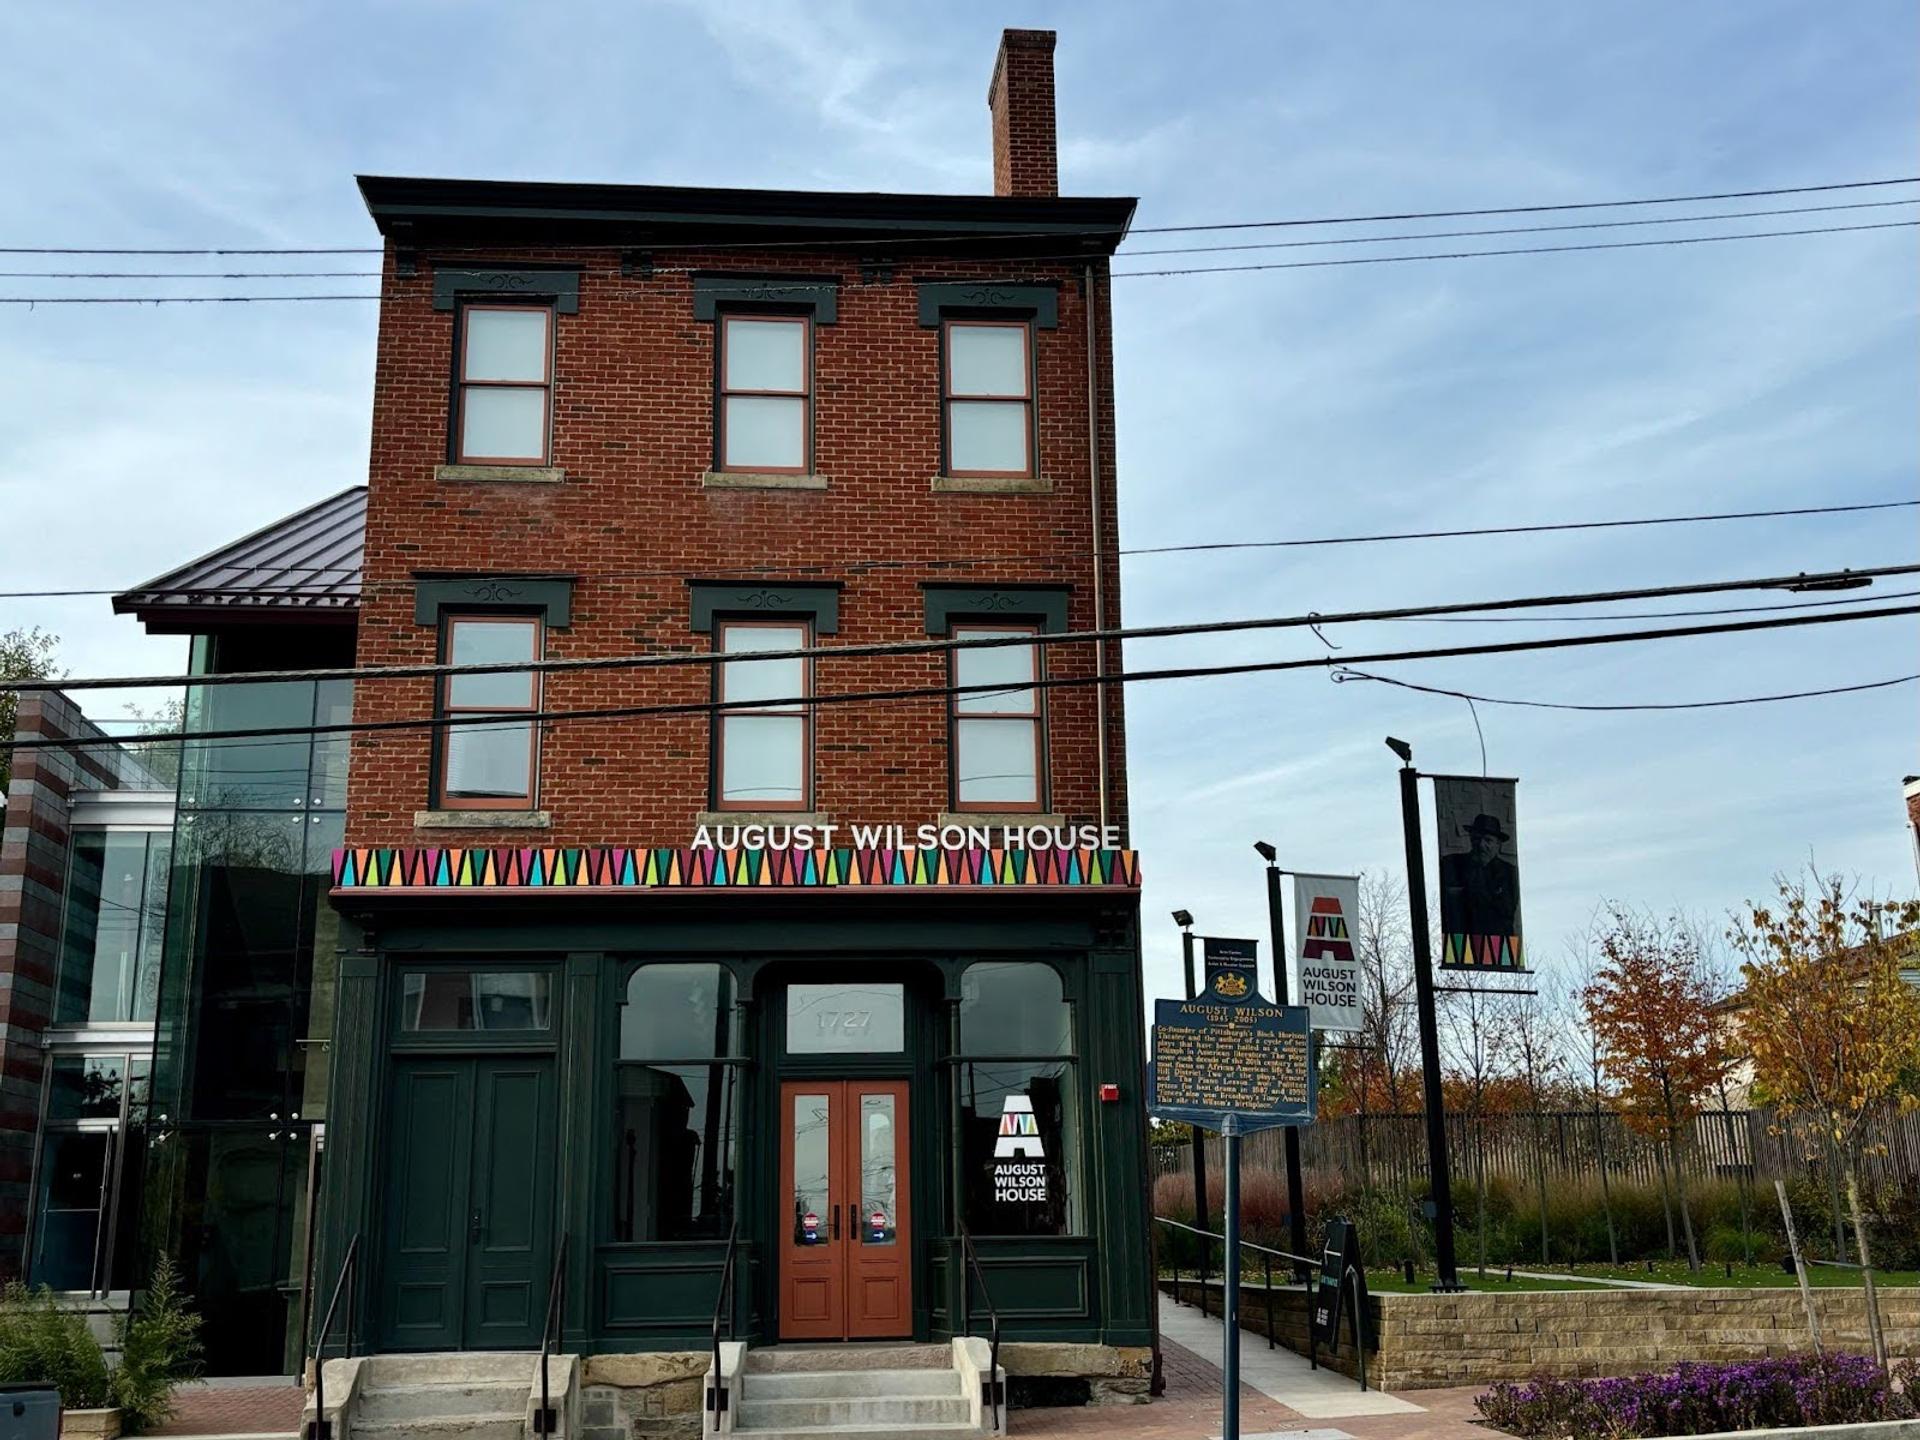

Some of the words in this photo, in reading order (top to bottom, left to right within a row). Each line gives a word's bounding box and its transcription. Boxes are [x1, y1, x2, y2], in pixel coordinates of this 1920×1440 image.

[690, 825, 838, 850] AUGUST
[851, 825, 990, 850] WILSON
[1004, 825, 1121, 850] HOUSE
[1303, 967, 1356, 980] AUGUST
[1303, 979, 1356, 993] WILSON
[1304, 992, 1356, 1007] HOUSE
[1180, 1005, 1229, 1015] AUGUST
[1235, 1007, 1283, 1018] WILSON
[817, 1010, 872, 1028] 1727
[994, 1164, 1046, 1175] AUGUST
[994, 1176, 1046, 1187] WILSON
[995, 1189, 1046, 1202] HOUSE
